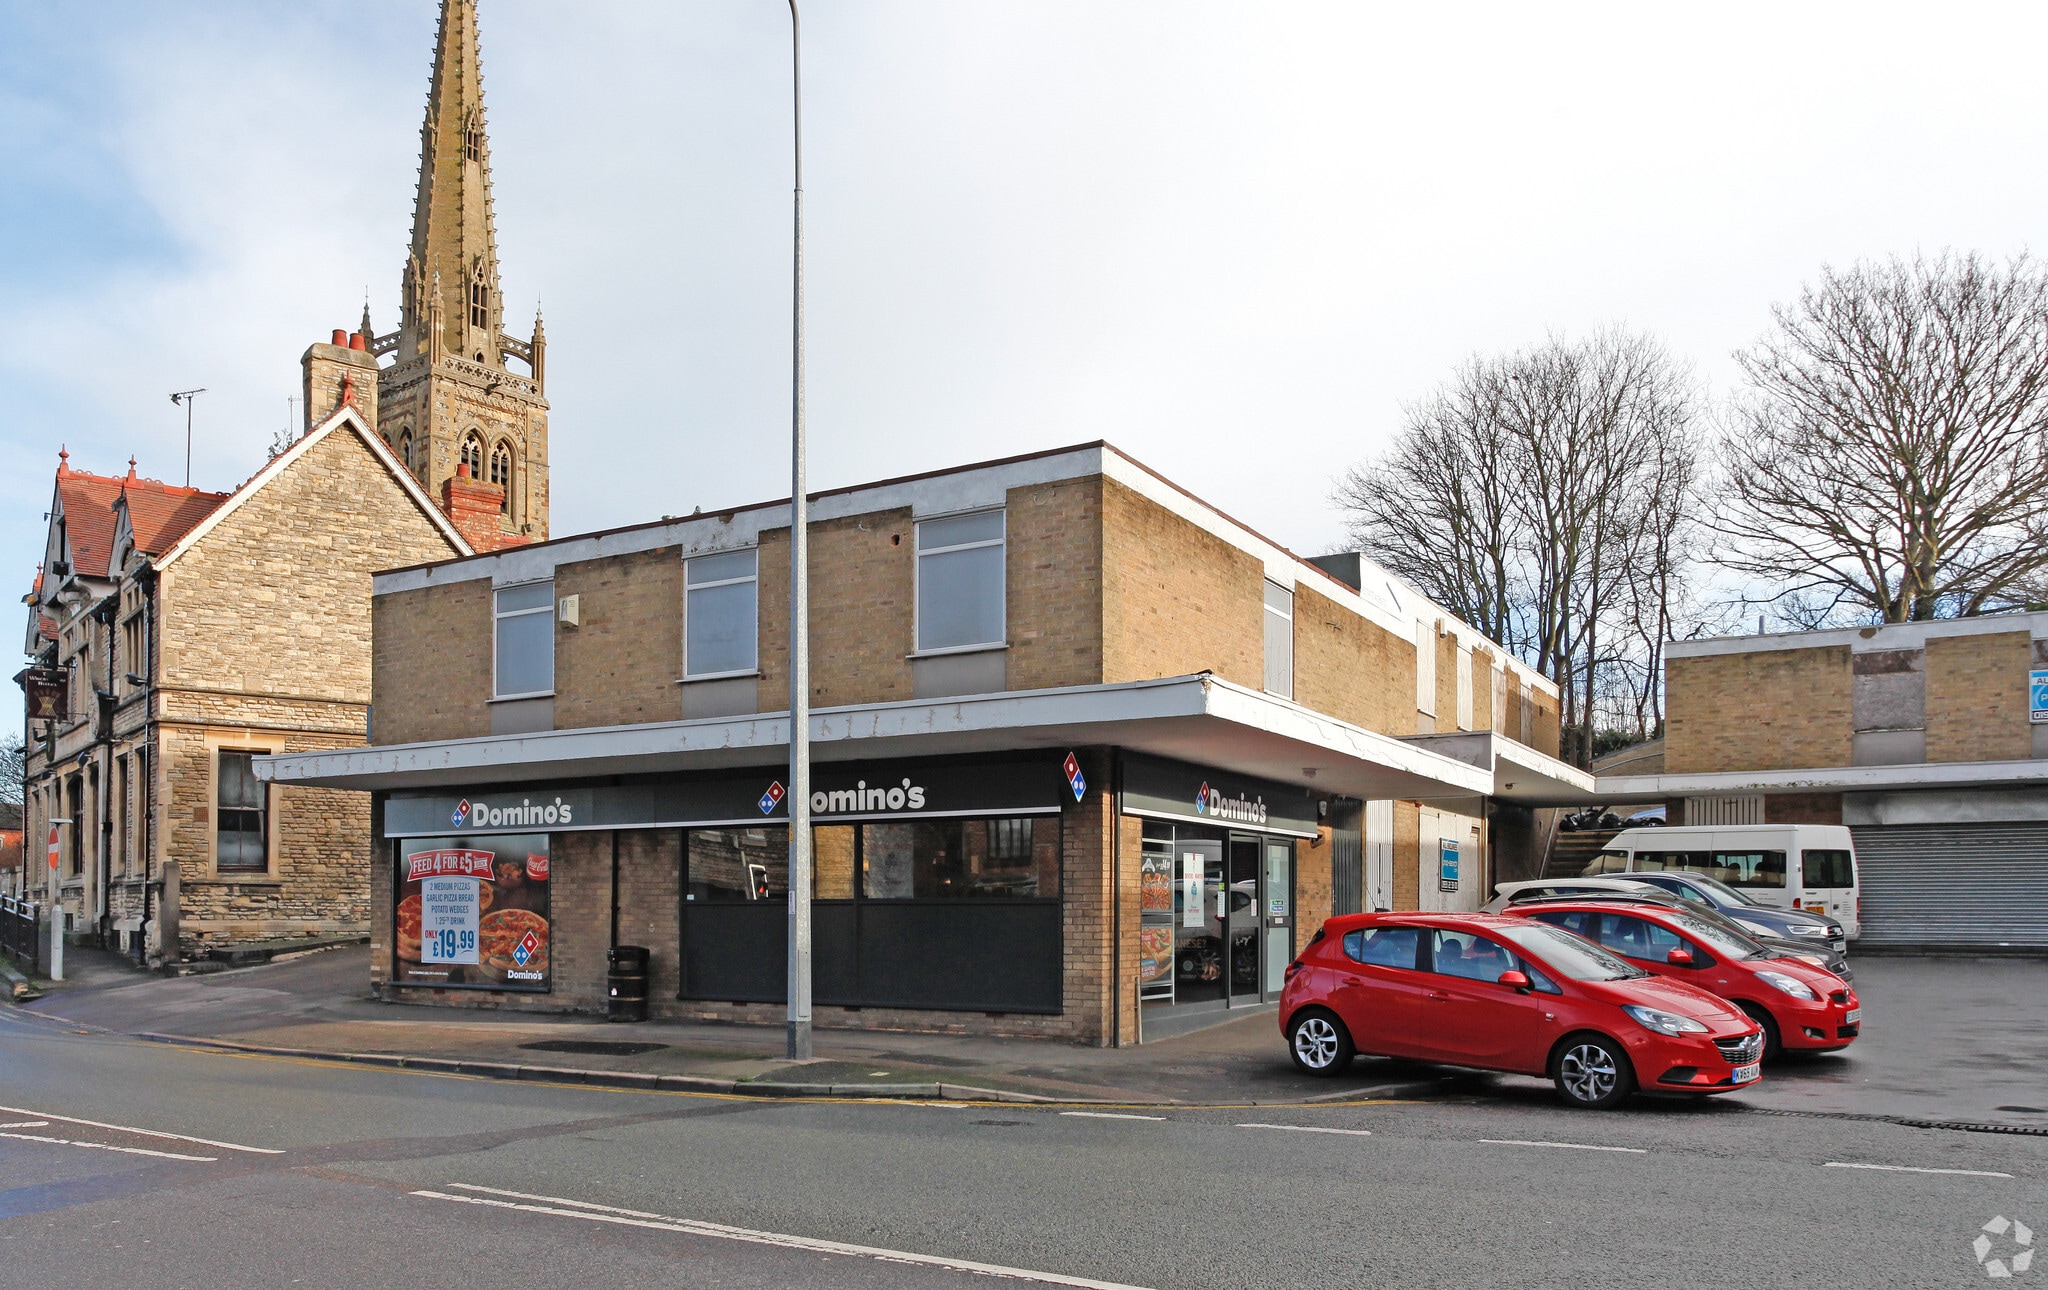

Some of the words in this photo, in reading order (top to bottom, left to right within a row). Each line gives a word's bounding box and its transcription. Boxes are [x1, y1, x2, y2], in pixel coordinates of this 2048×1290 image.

[788, 778, 926, 813] omino's
[1209, 788, 1267, 824] Domino's
[472, 797, 572, 827] Domino's
[413, 858, 432, 873] FEED
[433, 853, 442, 874] 4
[442, 856, 458, 870] FOR
[459, 852, 473, 874] £5
[434, 882, 454, 890] MEDIUM
[454, 882, 471, 891] PIZZAS
[426, 894, 443, 902] GARLIC
[443, 894, 458, 902] PIZZA
[458, 894, 475, 902] BREAD
[431, 905, 449, 913] POTATO
[449, 905, 469, 914] WEDGES
[450, 917, 466, 925] DRINK
[424, 929, 438, 939] ONLY
[507, 969, 543, 980] Domino's
